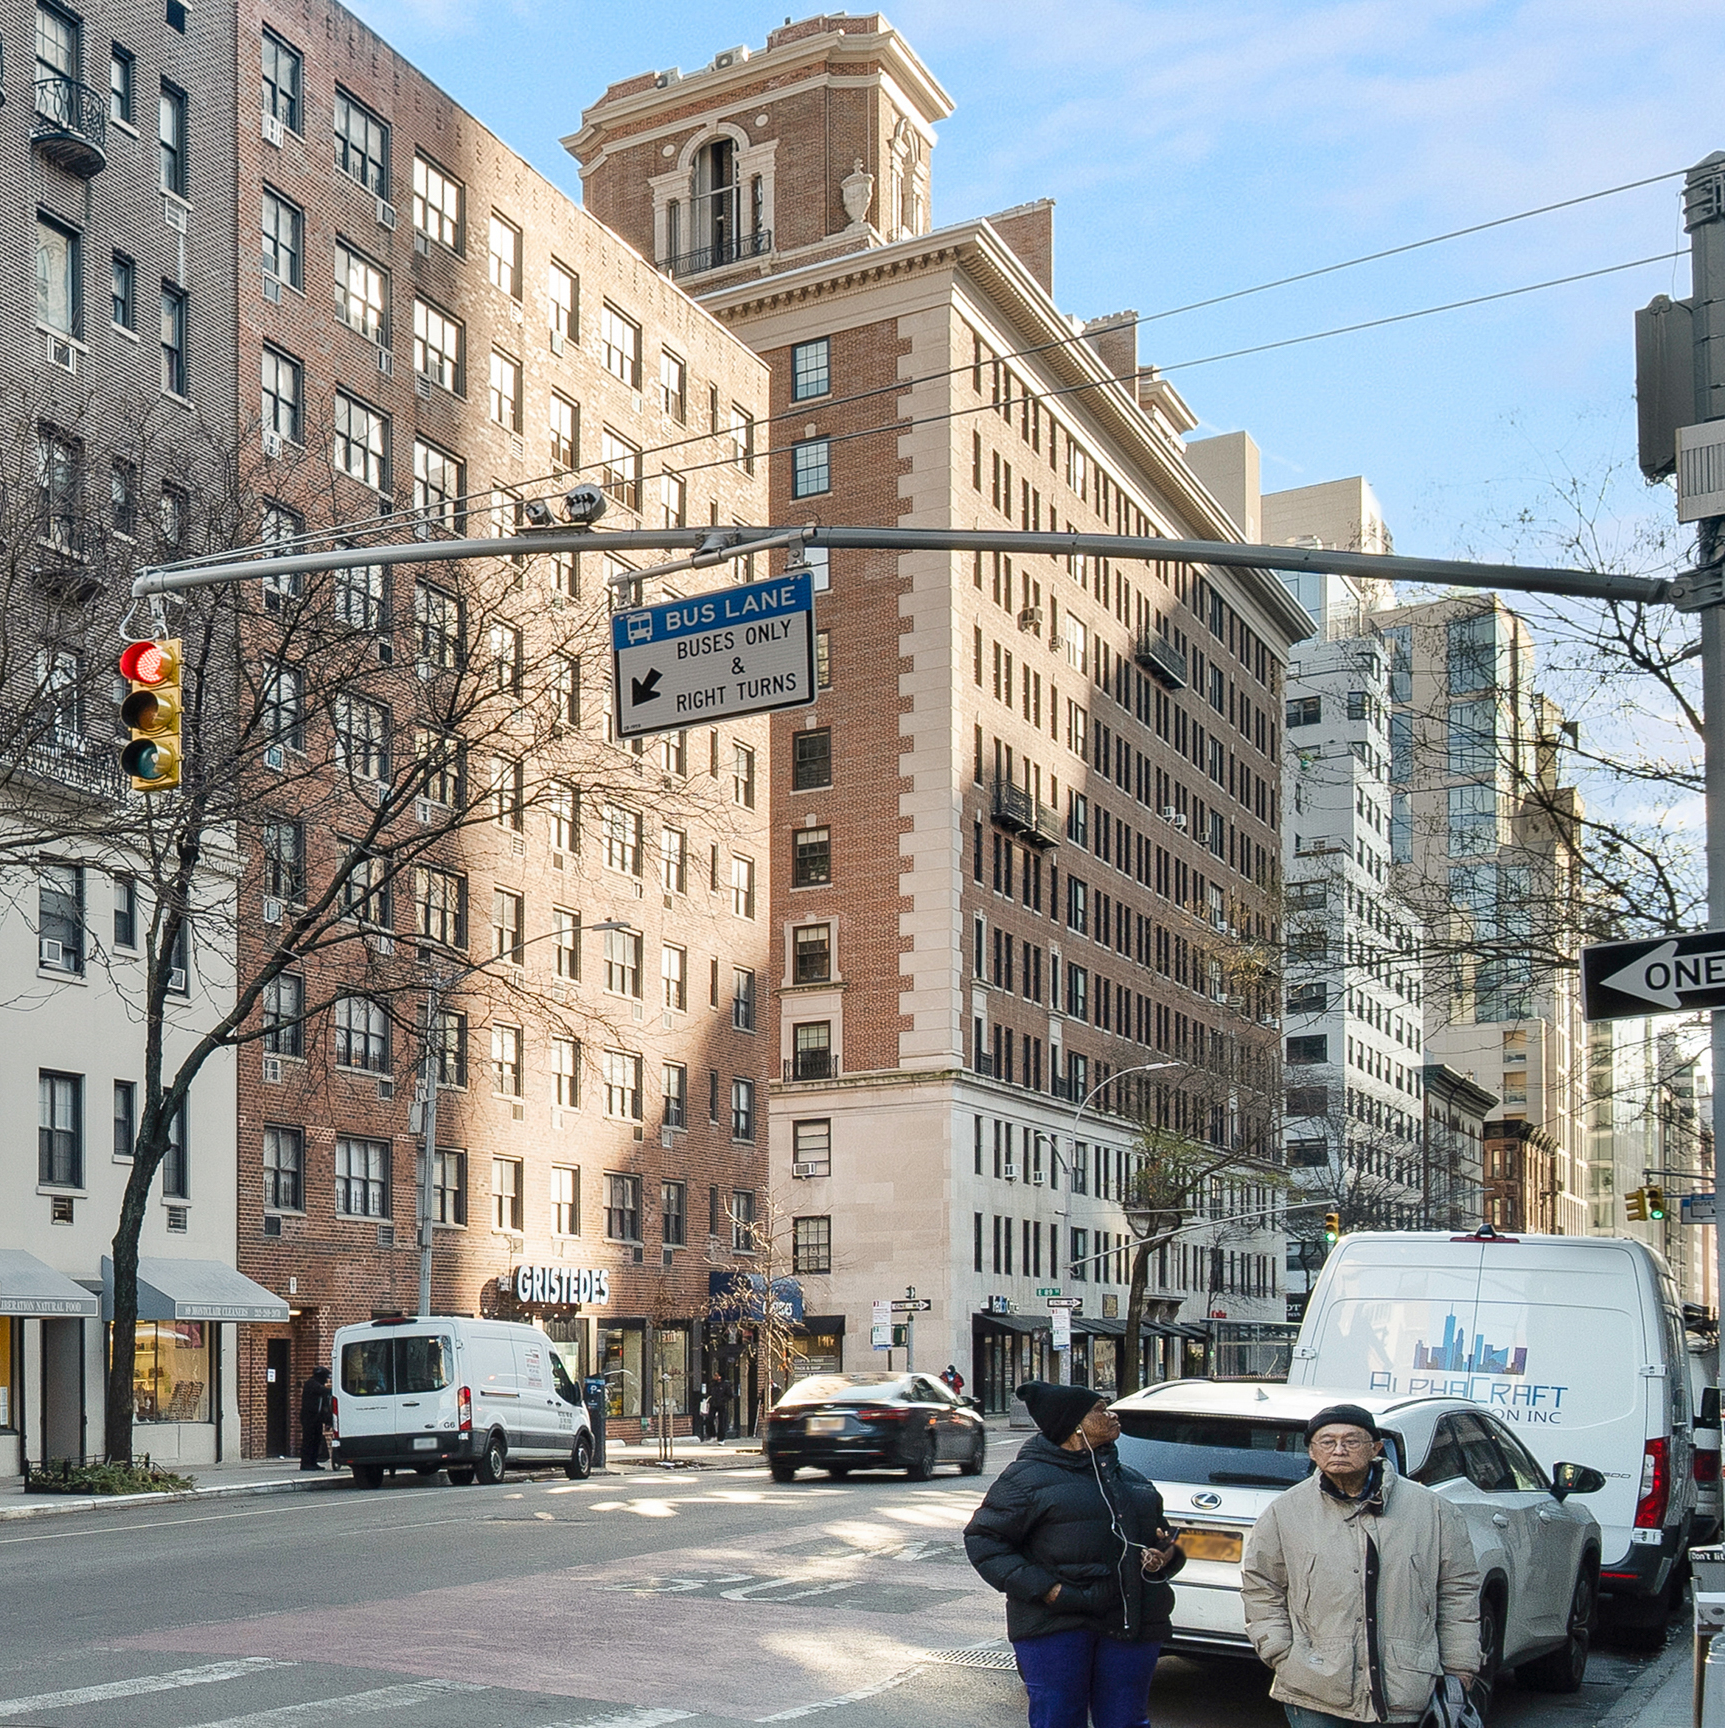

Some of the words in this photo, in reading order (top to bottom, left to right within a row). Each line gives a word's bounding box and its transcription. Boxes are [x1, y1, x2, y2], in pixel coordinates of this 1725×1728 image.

[665, 603, 716, 631] BUS
[725, 585, 796, 618] LANE
[677, 631, 735, 660] BUSES
[745, 618, 792, 645] ONLY
[731, 656, 746, 675] &
[676, 685, 727, 712] RIGHT
[736, 672, 797, 701] TURNS
[1644, 954, 1725, 991] ONE
[517, 1264, 610, 1305] GRISTEDES
[0, 1299, 34, 1312] IBERATION
[65, 1301, 82, 1312] FOOD
[1527, 1410, 1561, 1424] INC
[1691, 1552, 1711, 1561] Don't
